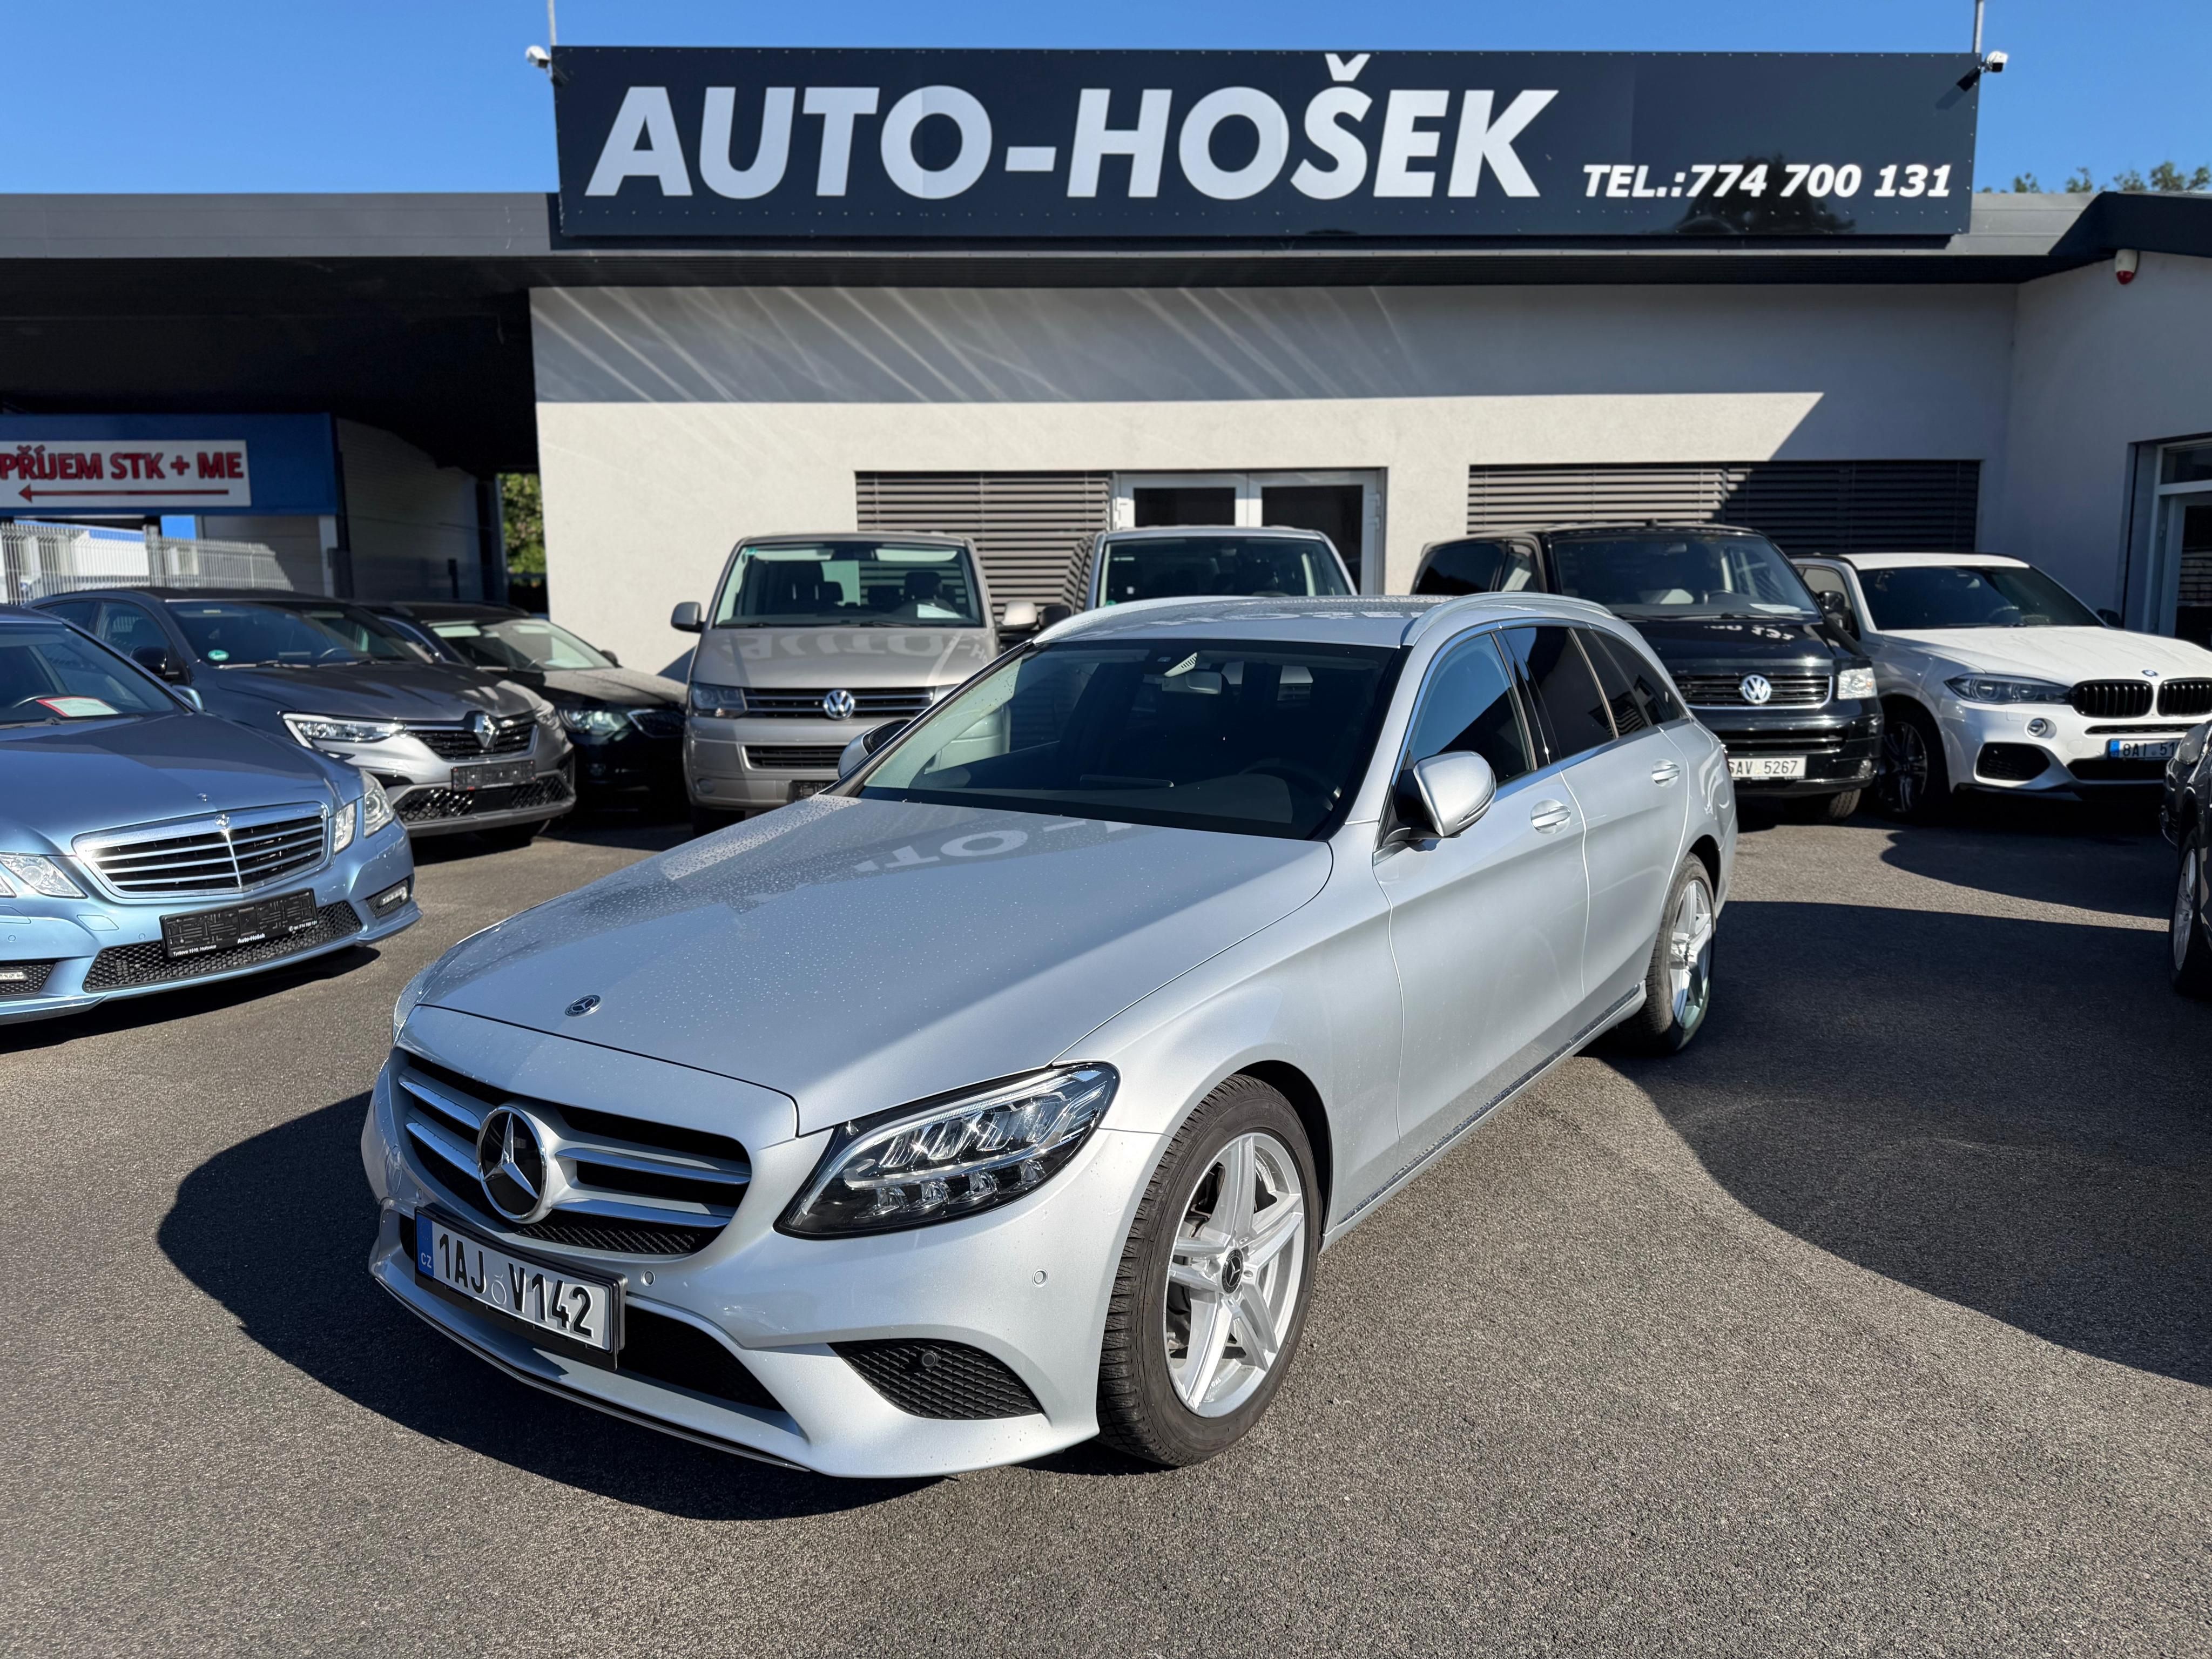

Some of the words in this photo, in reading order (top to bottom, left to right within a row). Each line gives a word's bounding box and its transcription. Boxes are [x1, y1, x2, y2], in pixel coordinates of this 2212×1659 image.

[584, 53, 1559, 200] AUTO-HOŠEK
[1780, 164, 1862, 198] 700
[1873, 164, 1952, 197] 131
[0, 444, 103, 480] PŘÍJEM
[110, 452, 165, 479] STK
[197, 452, 244, 478] ME
[2122, 744, 2147, 757] 8AI
[2160, 742, 2180, 756] 51
[1764, 760, 1798, 774] 5267
[421, 1252, 432, 1269] CZ
[440, 1233, 486, 1293] 1AJ
[508, 1263, 594, 1338] V142
